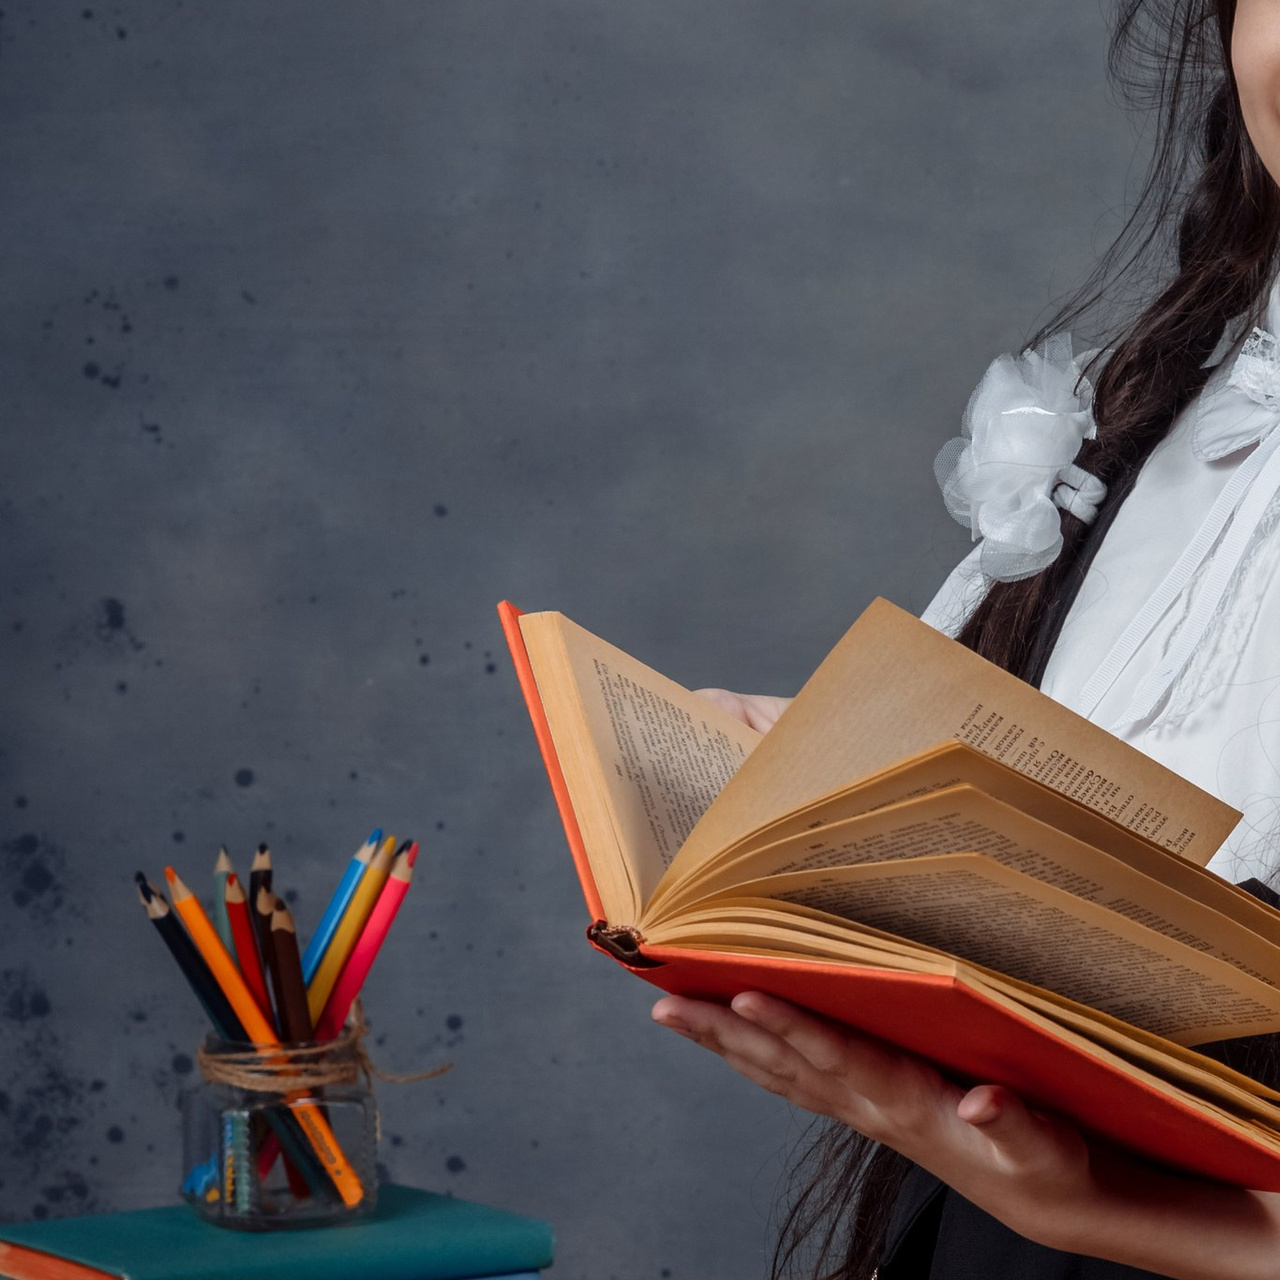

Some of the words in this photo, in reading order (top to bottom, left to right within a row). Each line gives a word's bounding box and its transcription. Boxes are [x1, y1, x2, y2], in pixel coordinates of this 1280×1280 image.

[961, 704, 983, 730] цессы
[963, 724, 980, 739] Так
[977, 716, 1003, 748] клятвы
[994, 724, 1017, 750] самой
[1028, 737, 1038, 748] ей
[1034, 750, 1059, 777] Отоми
[1064, 761, 1079, 778] нем
[1172, 828, 1189, 847] всех
